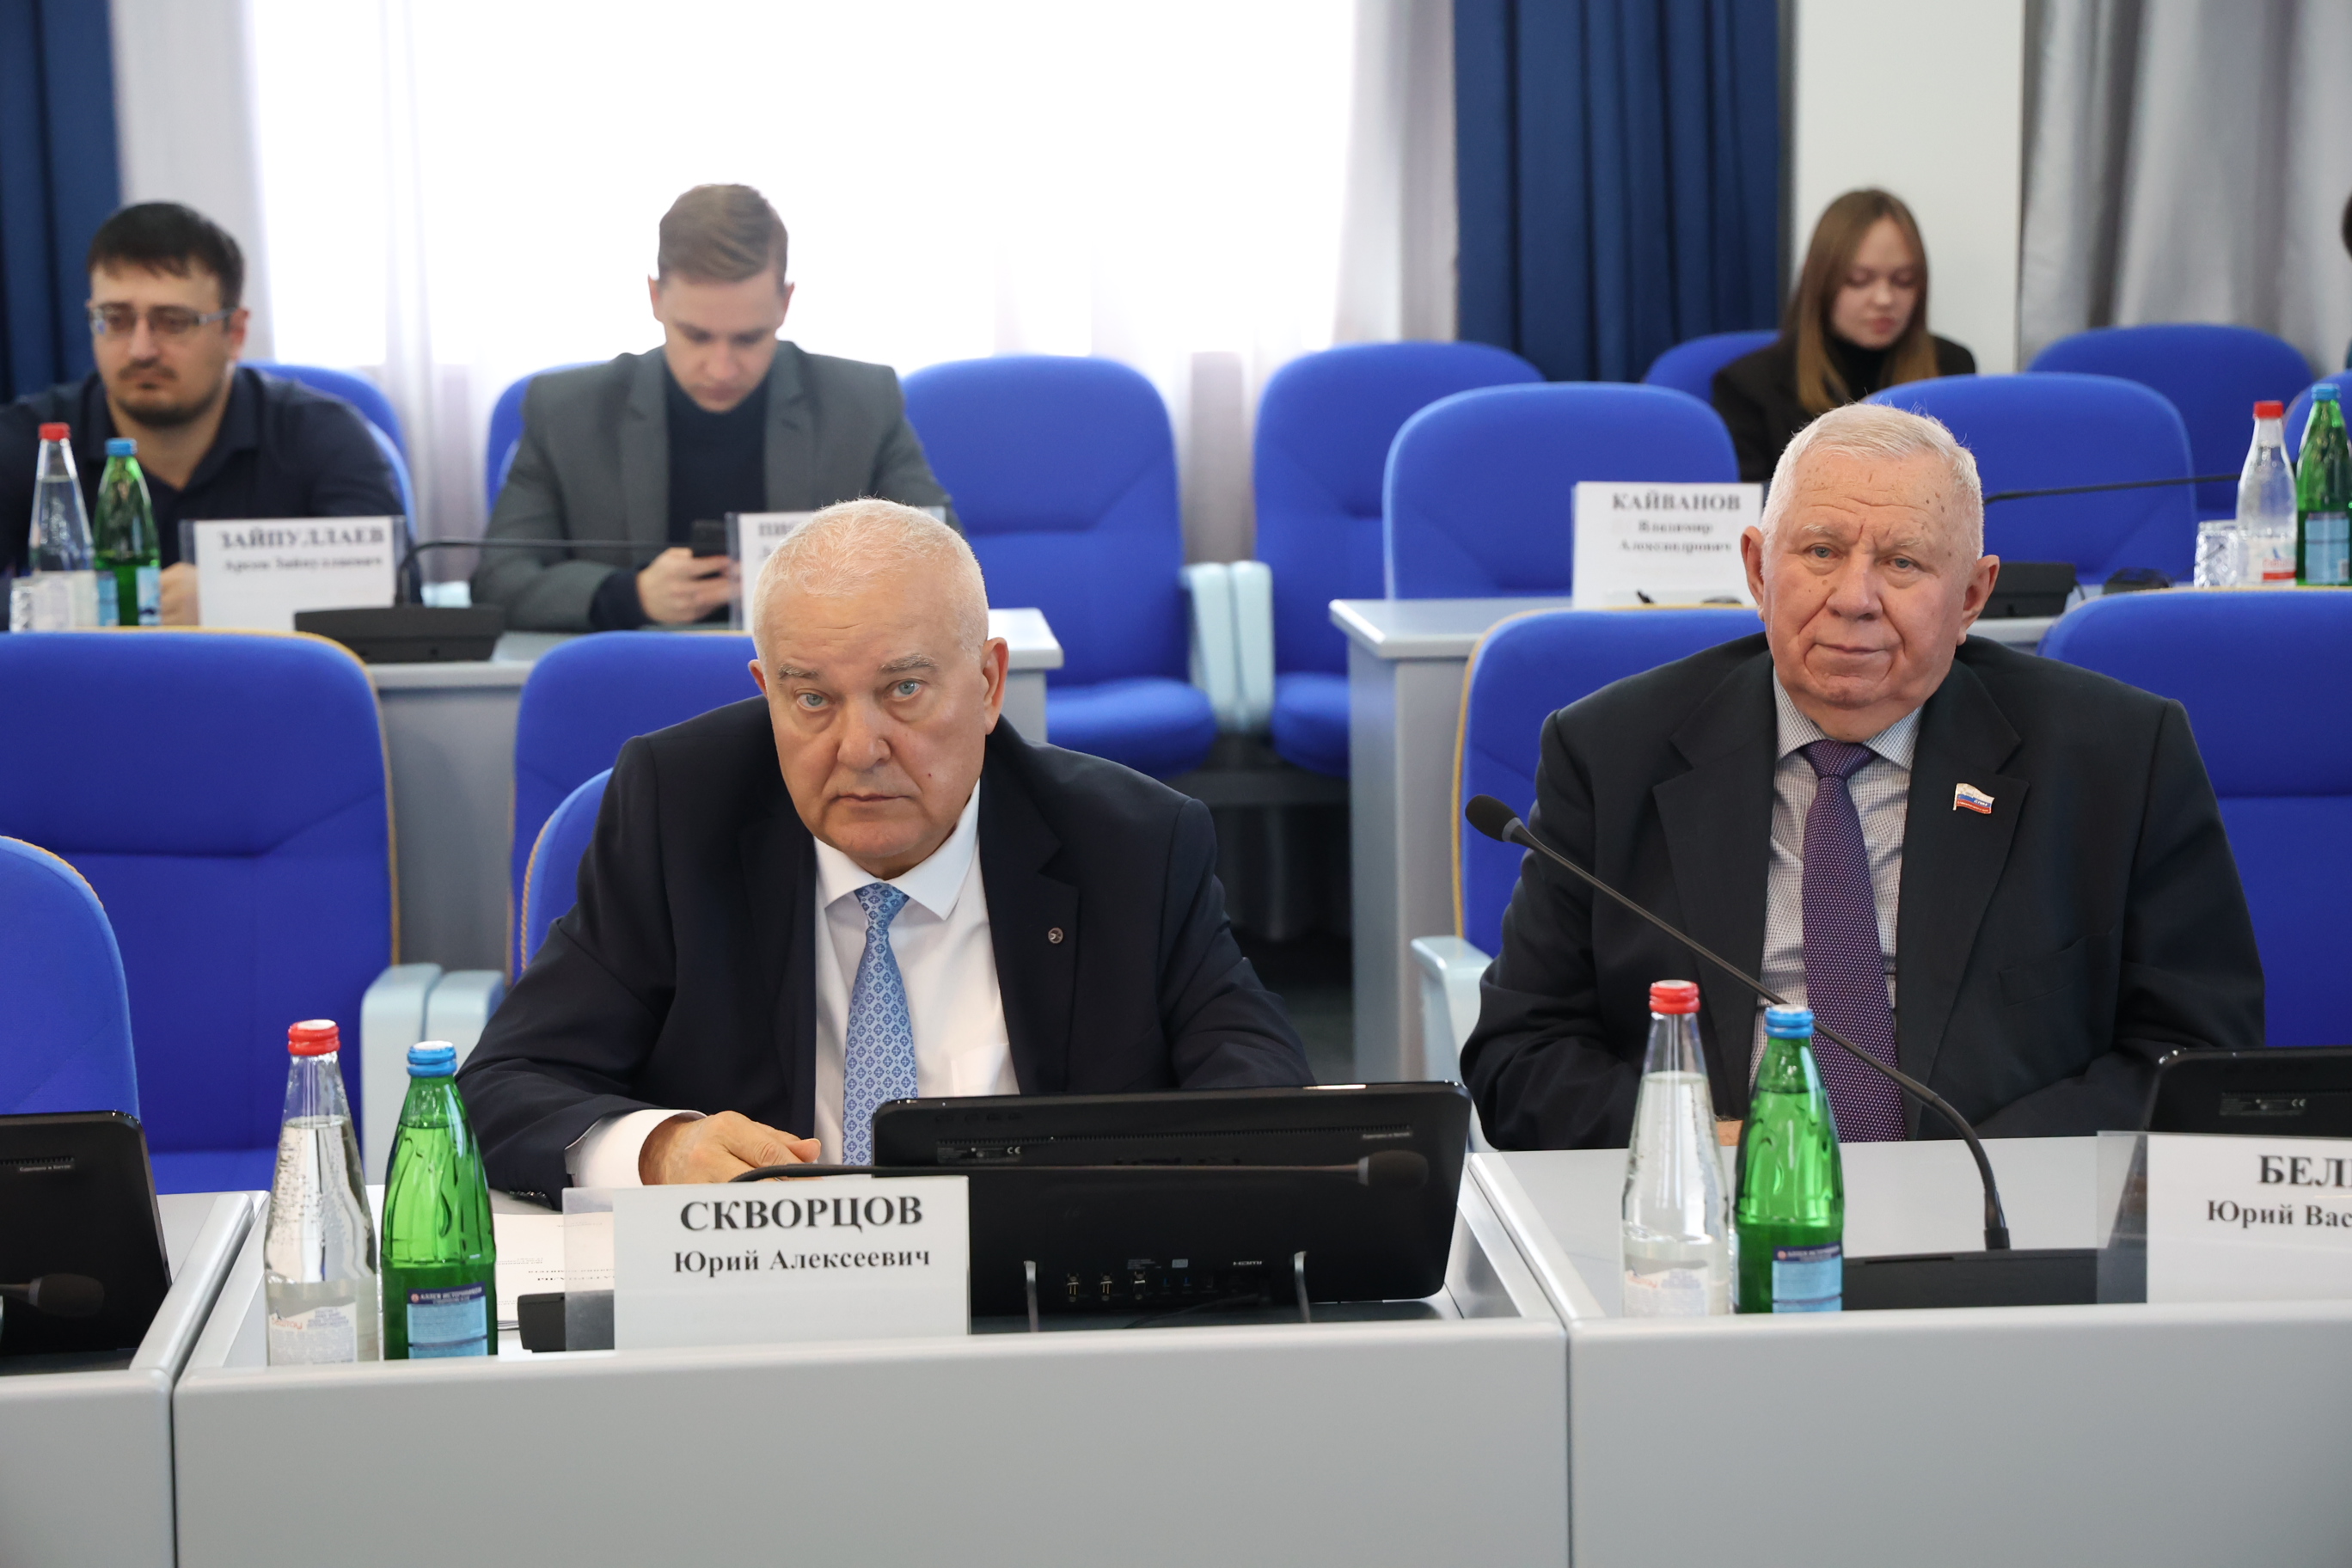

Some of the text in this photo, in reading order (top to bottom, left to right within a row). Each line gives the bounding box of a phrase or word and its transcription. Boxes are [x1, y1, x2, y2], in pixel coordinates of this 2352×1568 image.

[1612, 491, 1742, 511] КАЙВАНОВ
[2257, 1155, 2352, 1187] БЕЛ
[680, 1196, 923, 1233] СКВОРЦОВ
[2208, 1200, 2294, 1228] Юрий
[674, 1249, 930, 1277] Юрий Алексеевич
